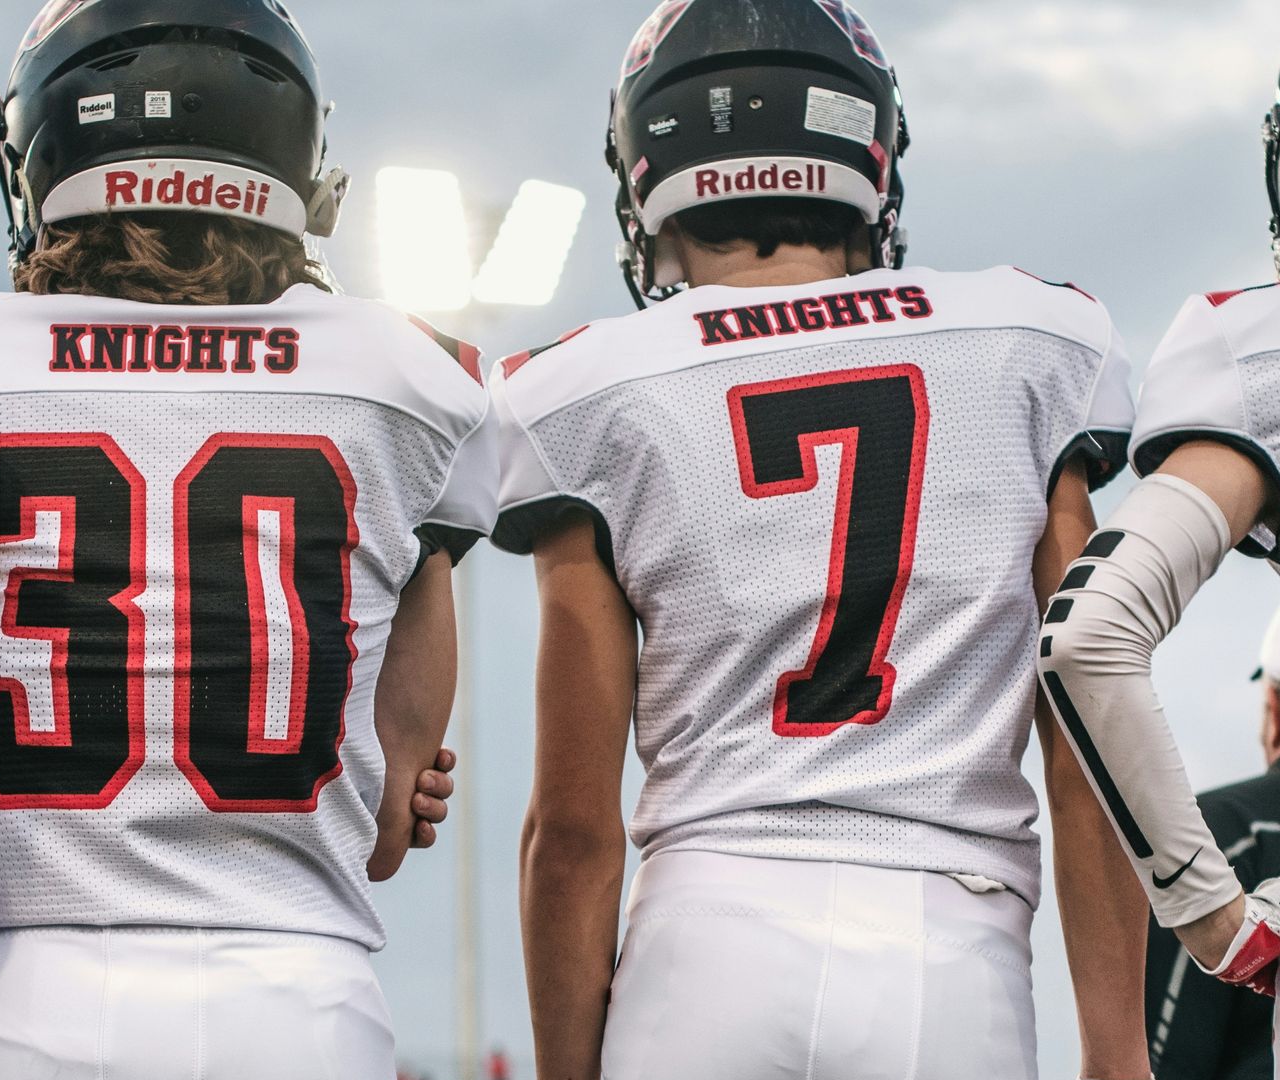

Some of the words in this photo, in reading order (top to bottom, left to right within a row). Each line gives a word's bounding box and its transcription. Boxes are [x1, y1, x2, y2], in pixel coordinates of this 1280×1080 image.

[80, 102, 112, 114] Riddell
[696, 164, 826, 198] Riddell
[693, 286, 933, 347] KNIGHTS
[48, 323, 300, 375] KNIGHTS
[726, 362, 930, 738] 7
